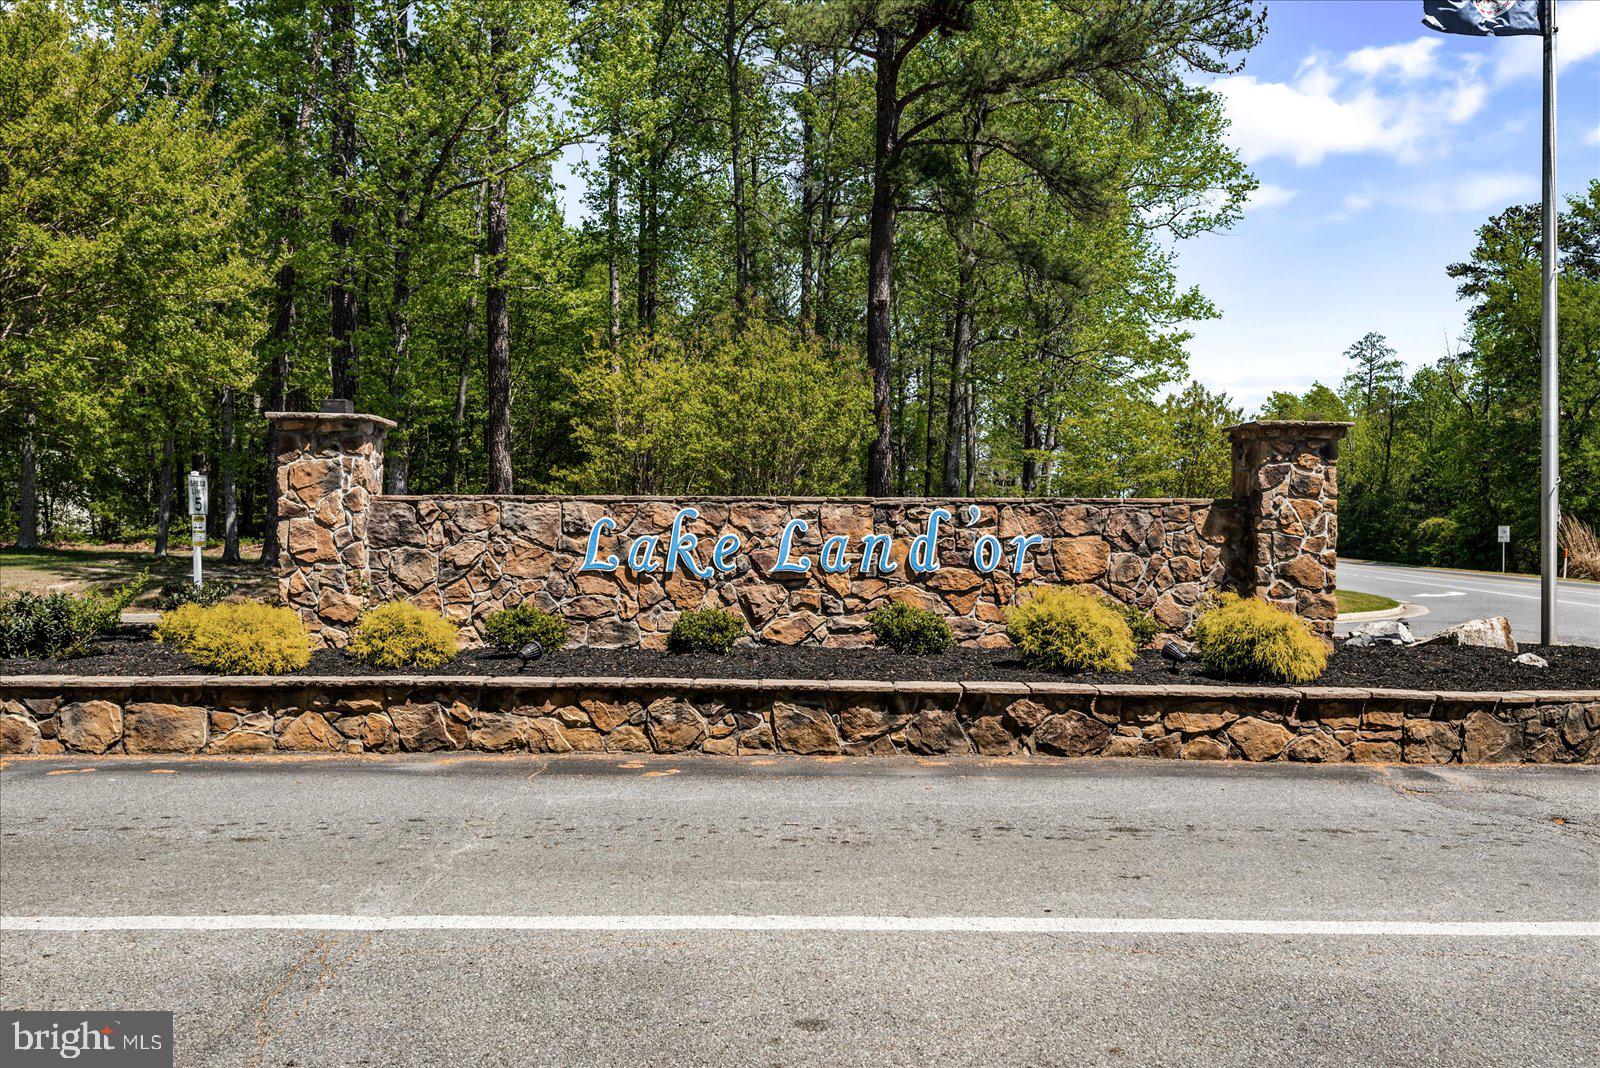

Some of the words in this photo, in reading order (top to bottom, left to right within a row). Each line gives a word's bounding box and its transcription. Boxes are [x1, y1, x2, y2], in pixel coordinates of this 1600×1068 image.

[195, 497, 202, 511] 5
[579, 507, 739, 578] Lake
[769, 507, 1044, 574] Land'or
